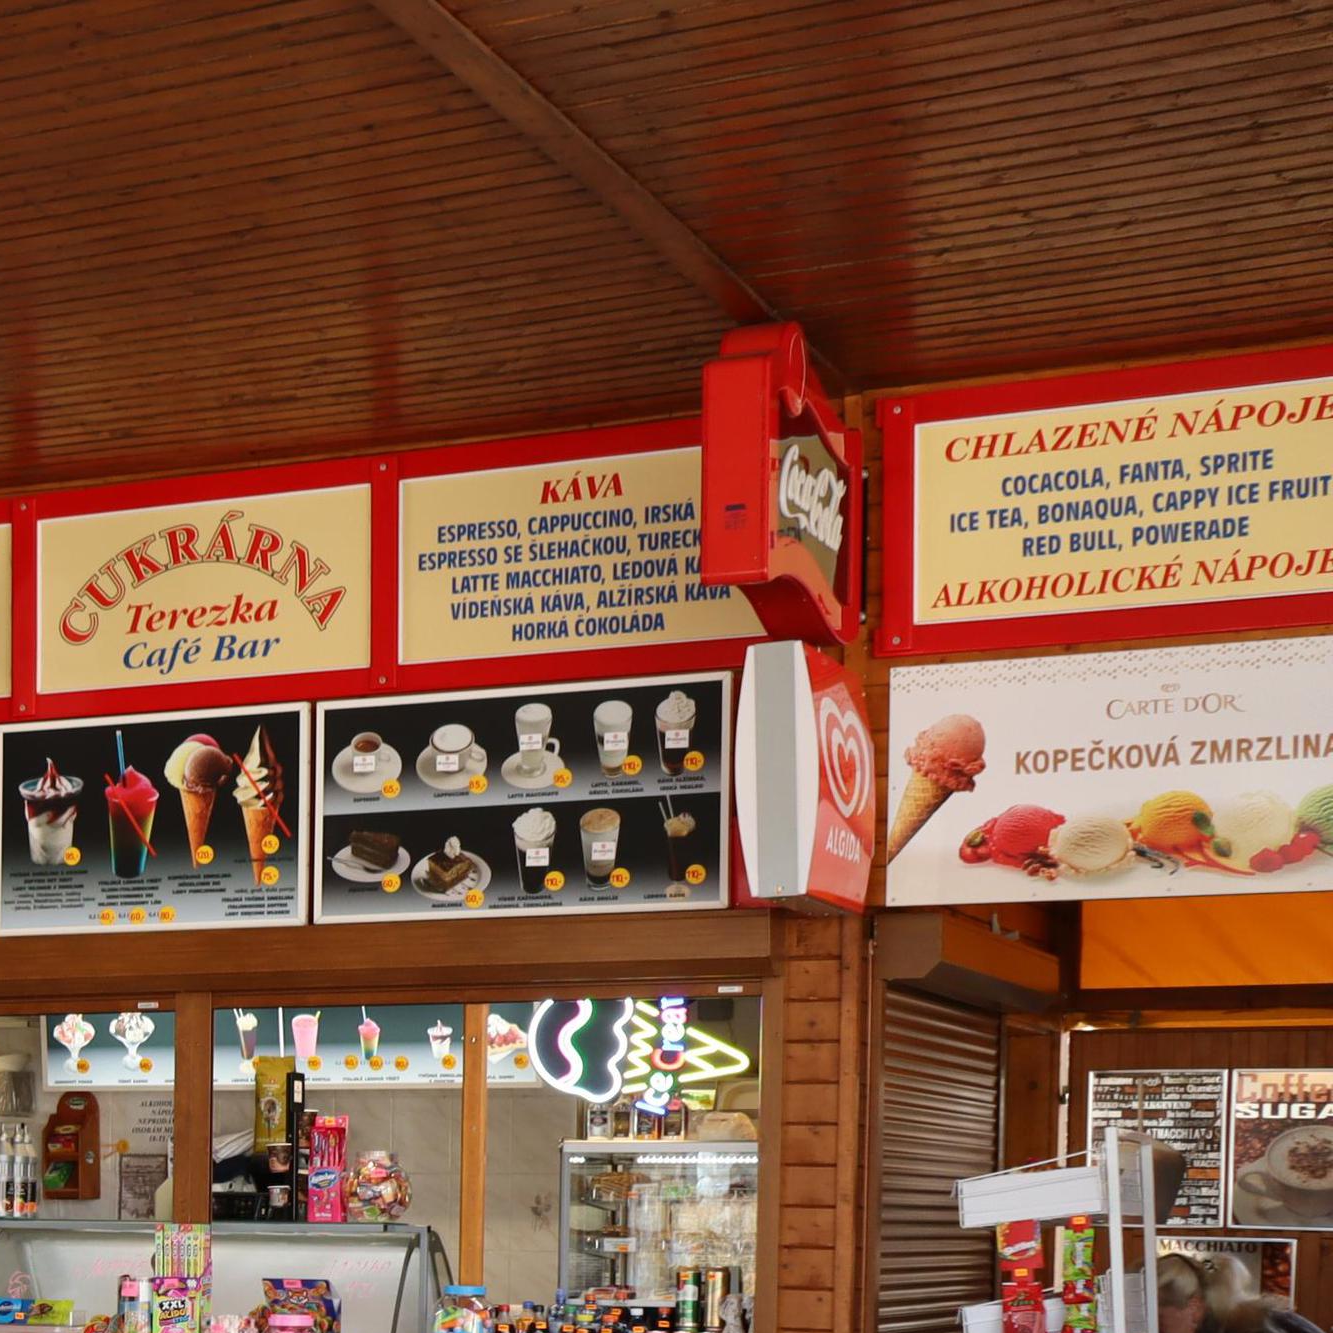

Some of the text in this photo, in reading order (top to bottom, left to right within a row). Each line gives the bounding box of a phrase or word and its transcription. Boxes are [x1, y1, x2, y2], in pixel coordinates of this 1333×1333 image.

[944, 407, 1158, 463] CHLAZENÉ
[540, 471, 624, 505] KÁVA
[1001, 449, 1274, 498] COCACOLA, FANTA, SPRITE
[437, 498, 696, 545] ESPRESSO, CAPPUCCINO, IRSKÁ
[950, 474, 1332, 533] ICE TEA, BONAQUA, CAPPY ICE FRUIT
[418, 546, 498, 572] ESPRESSO
[504, 544, 523, 564] SE
[529, 533, 631, 562] ŠLEHAČKOU,
[1022, 516, 1250, 558] RED BULL, POWERADE
[59, 510, 347, 646] CUKRÁRNA
[451, 552, 679, 595] LATTE MACCHIATO, LEDOVÁ
[931, 555, 1183, 610] ALKOHOLICKÉ
[125, 593, 278, 635] Terezka
[450, 582, 679, 621] VÍDEŇSKÁ KÁVA, ALŽÍRSKÁ
[512, 611, 666, 642] HORKÁ ČOKOLÁDA
[122, 633, 281, 675] Café Bar
[1105, 697, 1175, 721] CARTE
[1014, 734, 1181, 776] KOPEČKOVÁ
[825, 824, 862, 866] ALGIDA
[1159, 1239, 1258, 1255] MACCHIATO
